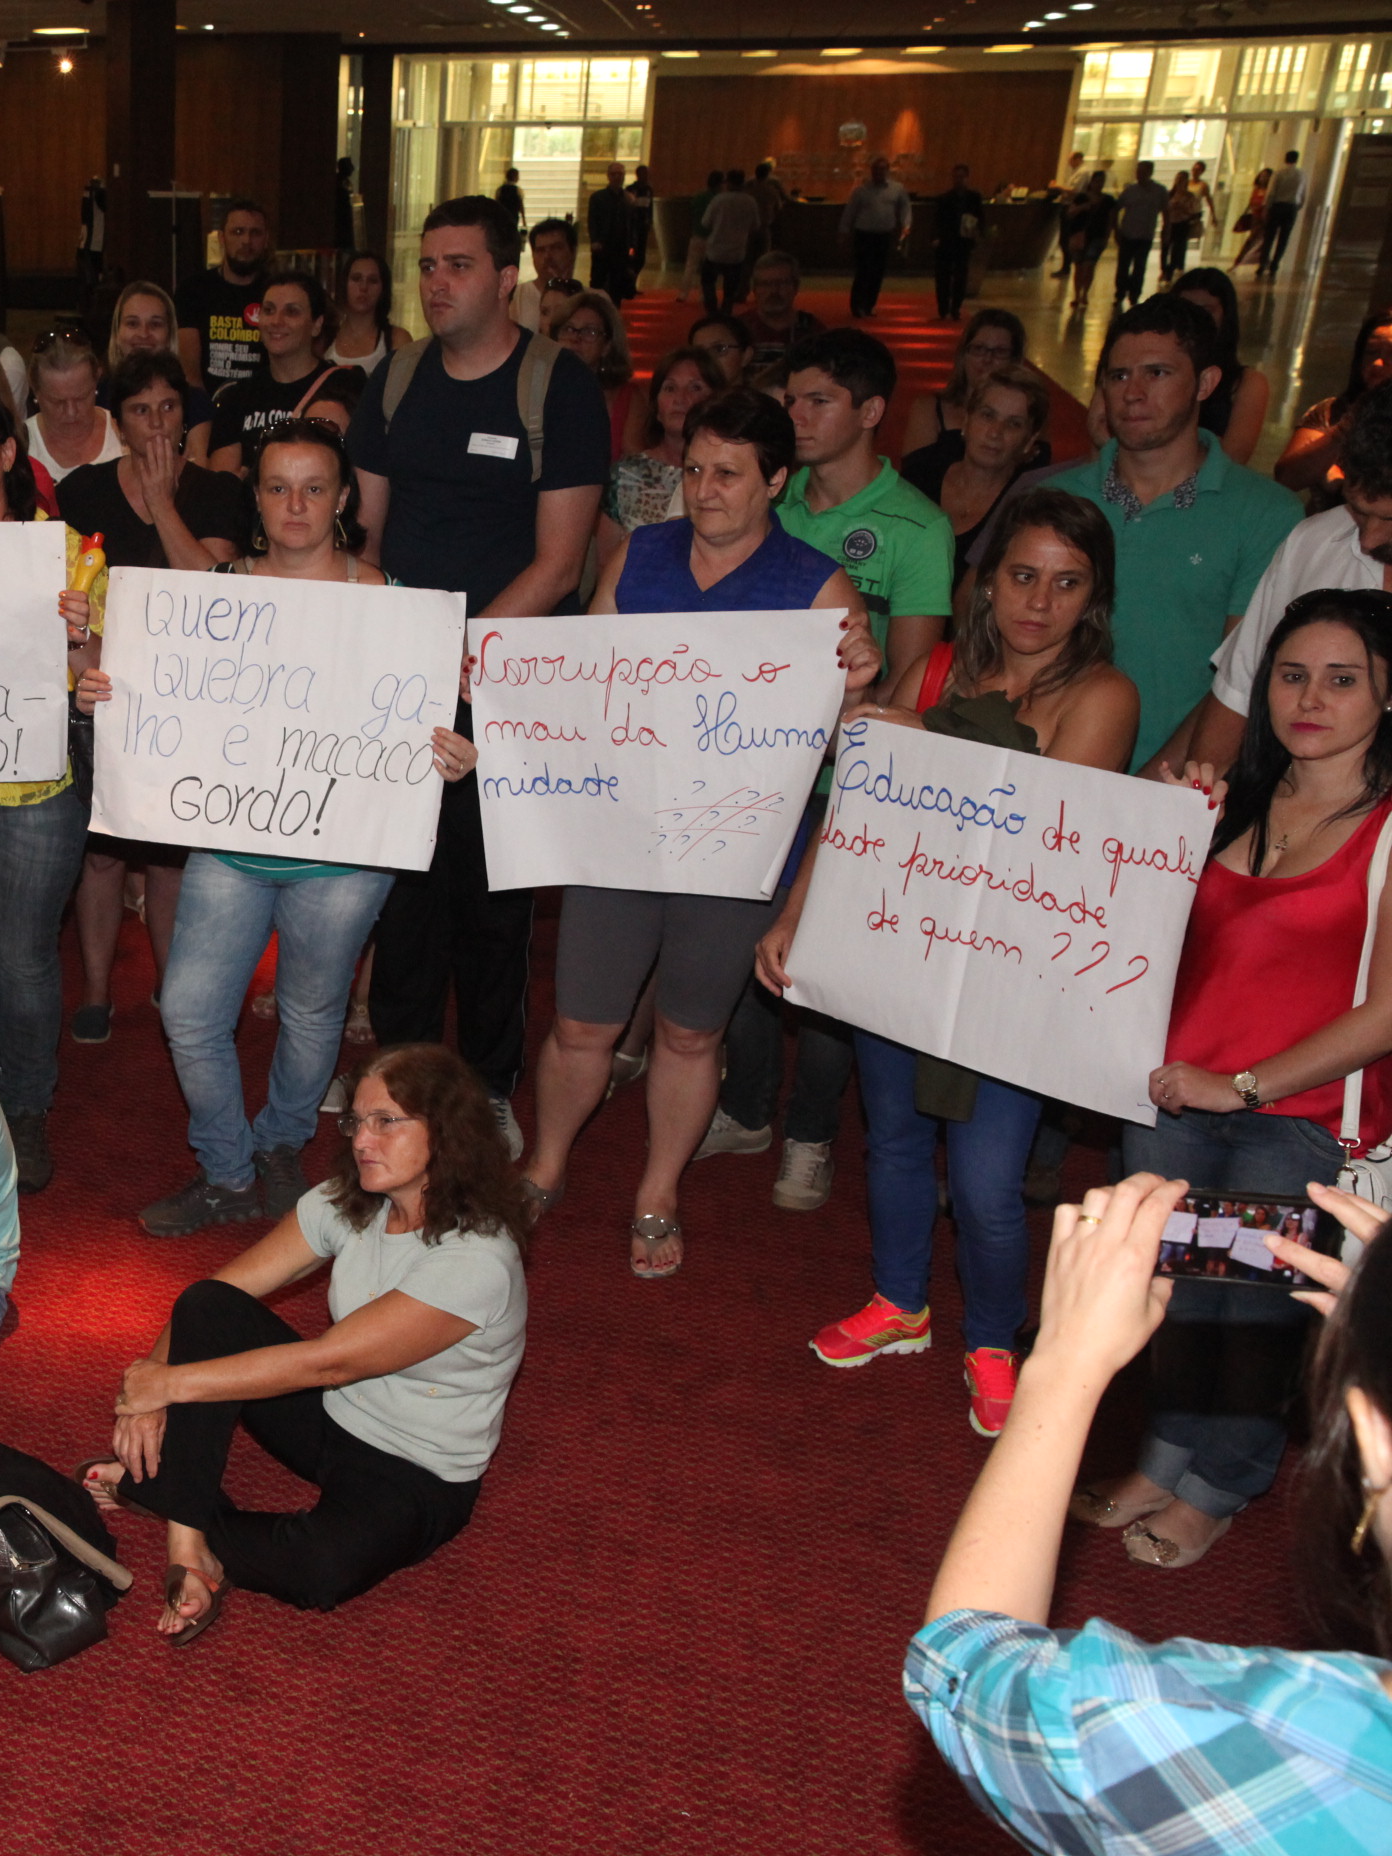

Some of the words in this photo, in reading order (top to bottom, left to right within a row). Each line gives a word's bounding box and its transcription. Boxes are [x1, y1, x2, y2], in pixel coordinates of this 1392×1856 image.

[209, 315, 243, 329] BASTA
[209, 327, 261, 342] COLOMBO
[145, 590, 277, 646] Quem
[474, 631, 723, 722] Corrupção
[741, 662, 791, 684] o
[222, 705, 257, 766] é
[276, 726, 436, 786] macaco
[610, 702, 668, 748] da
[169, 767, 338, 837] Gordo!
[483, 762, 620, 802] nidade
[836, 721, 1027, 834] Educação
[1041, 800, 1081, 855] de
[898, 831, 1108, 928] prioridade
[866, 888, 899, 934] de
[919, 916, 1023, 966] quem
